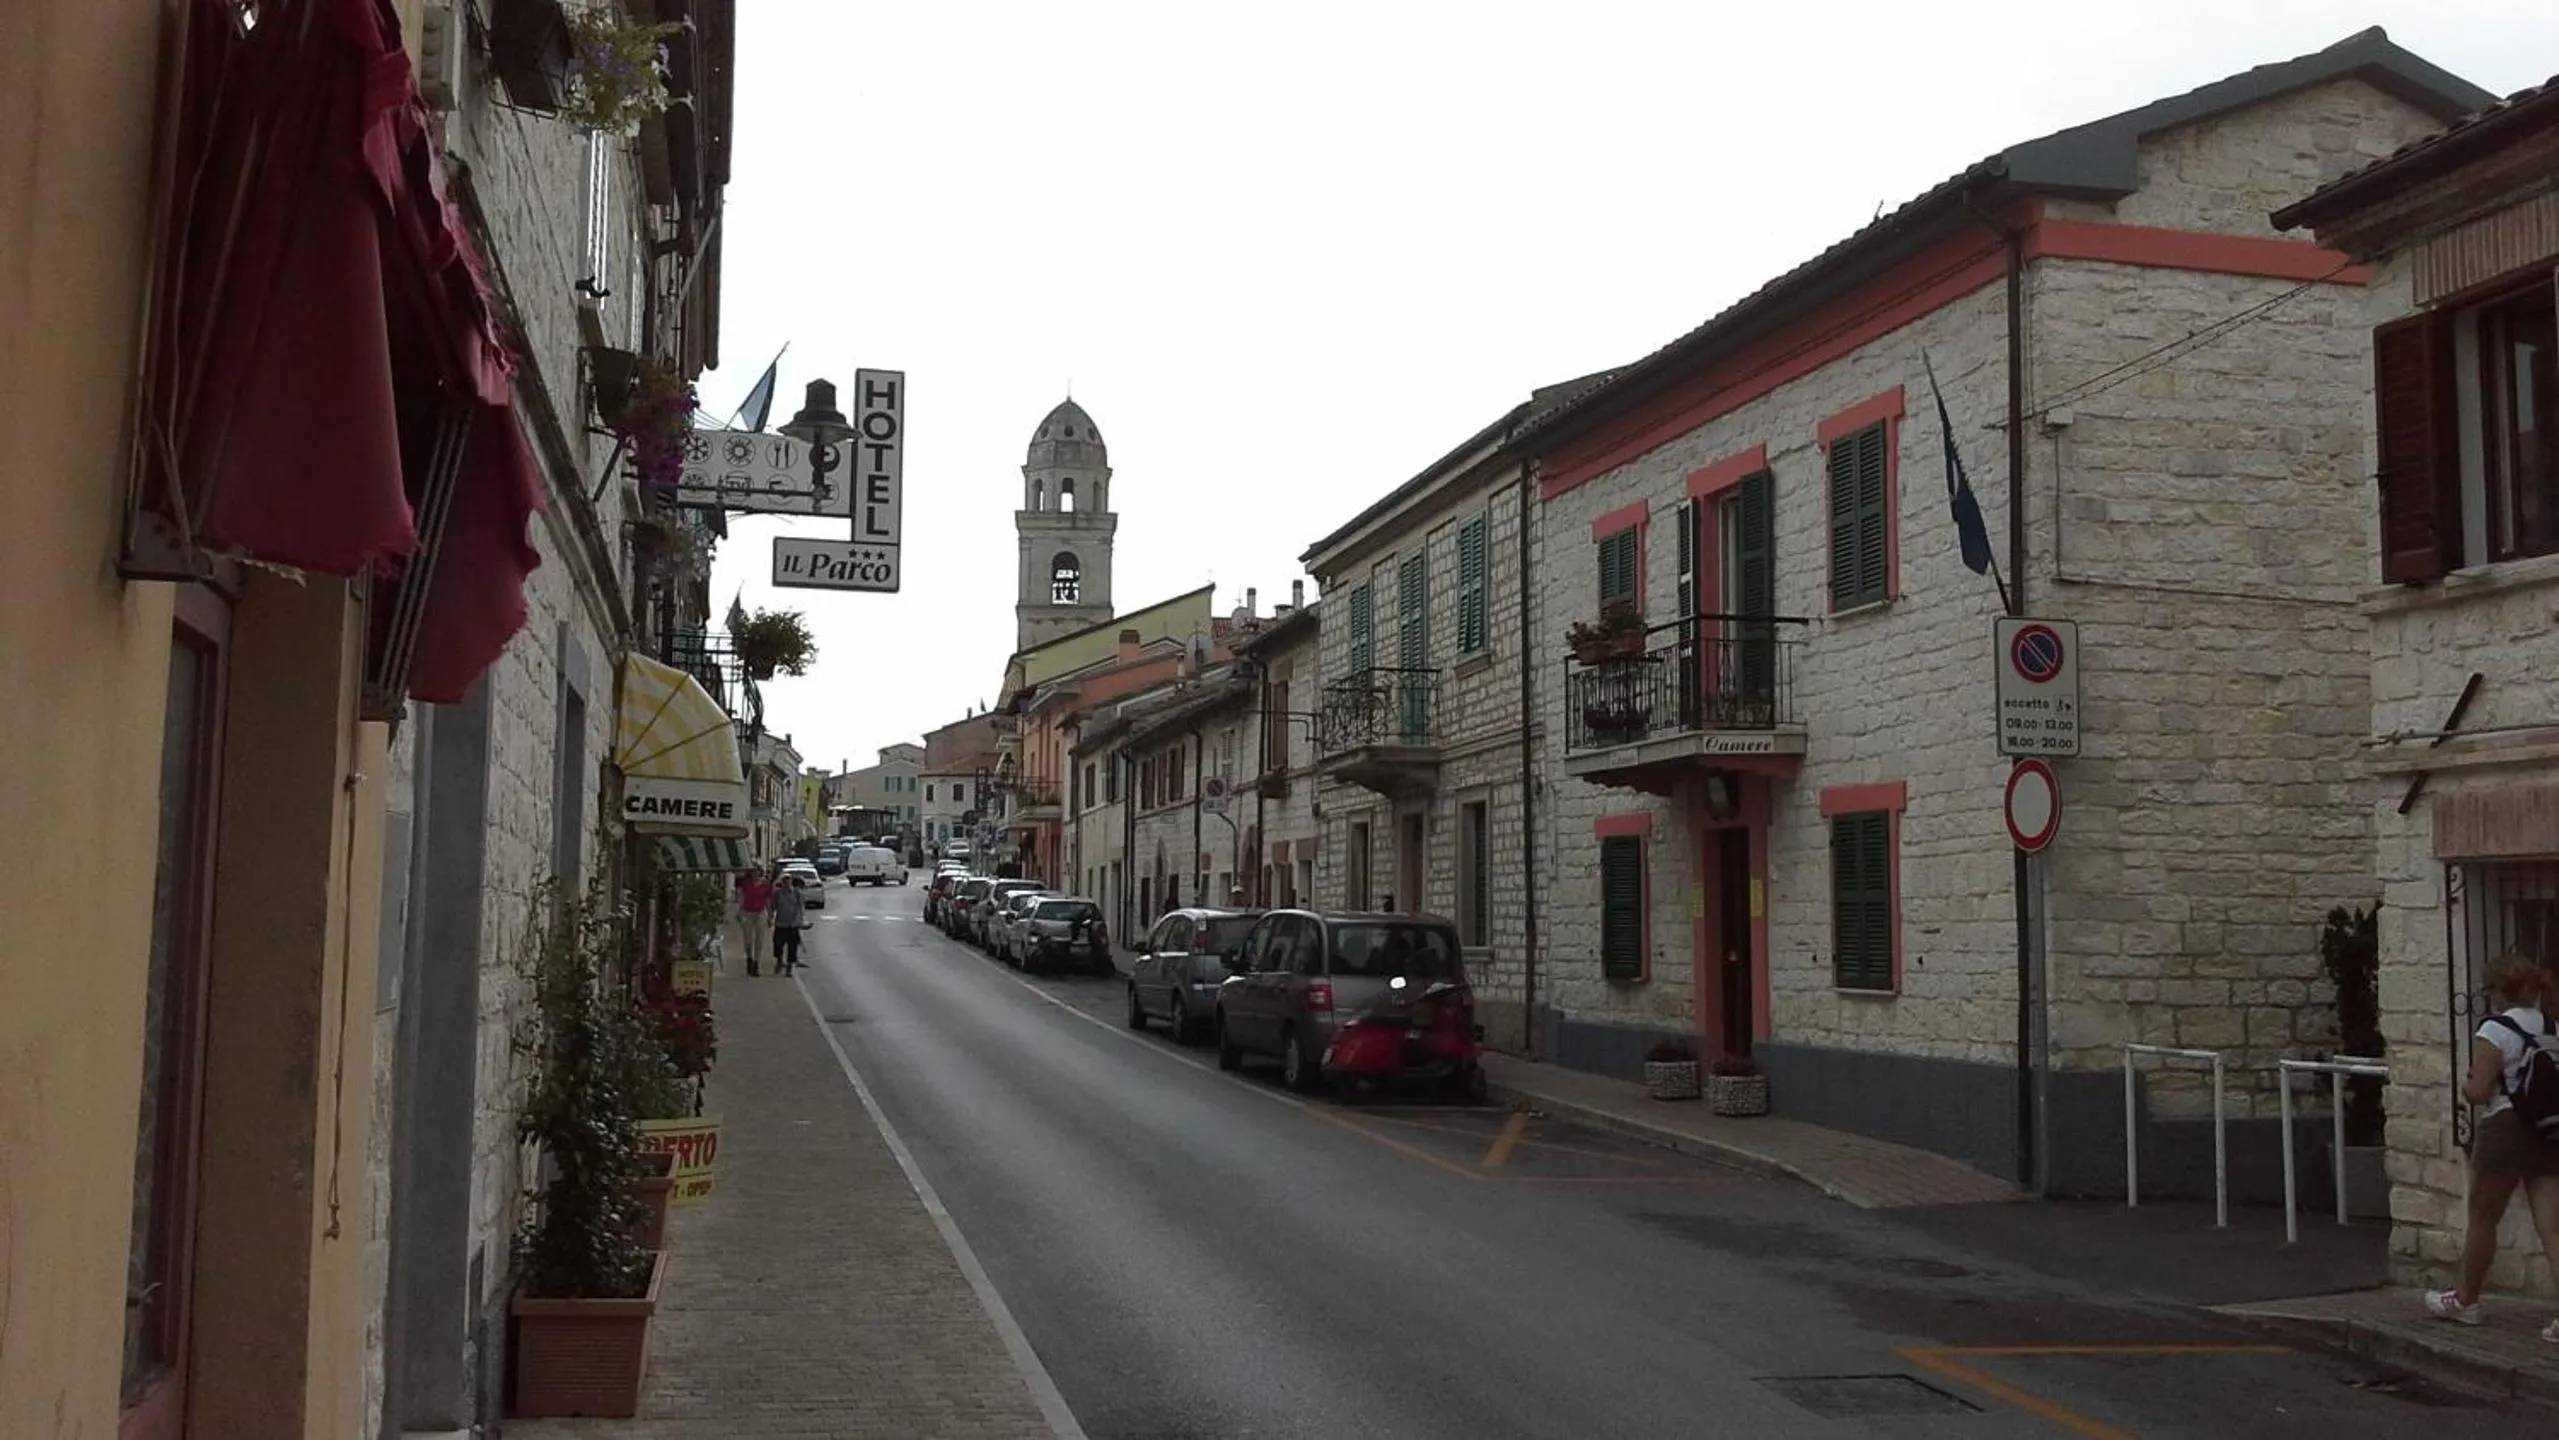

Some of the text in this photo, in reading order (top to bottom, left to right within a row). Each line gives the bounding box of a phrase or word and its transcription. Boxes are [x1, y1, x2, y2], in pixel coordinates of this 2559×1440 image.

[863, 380, 897, 536] HOTEL
[783, 553, 892, 583] IL Parco
[2004, 698, 2050, 709] eccetto
[625, 796, 733, 819] CAMERE
